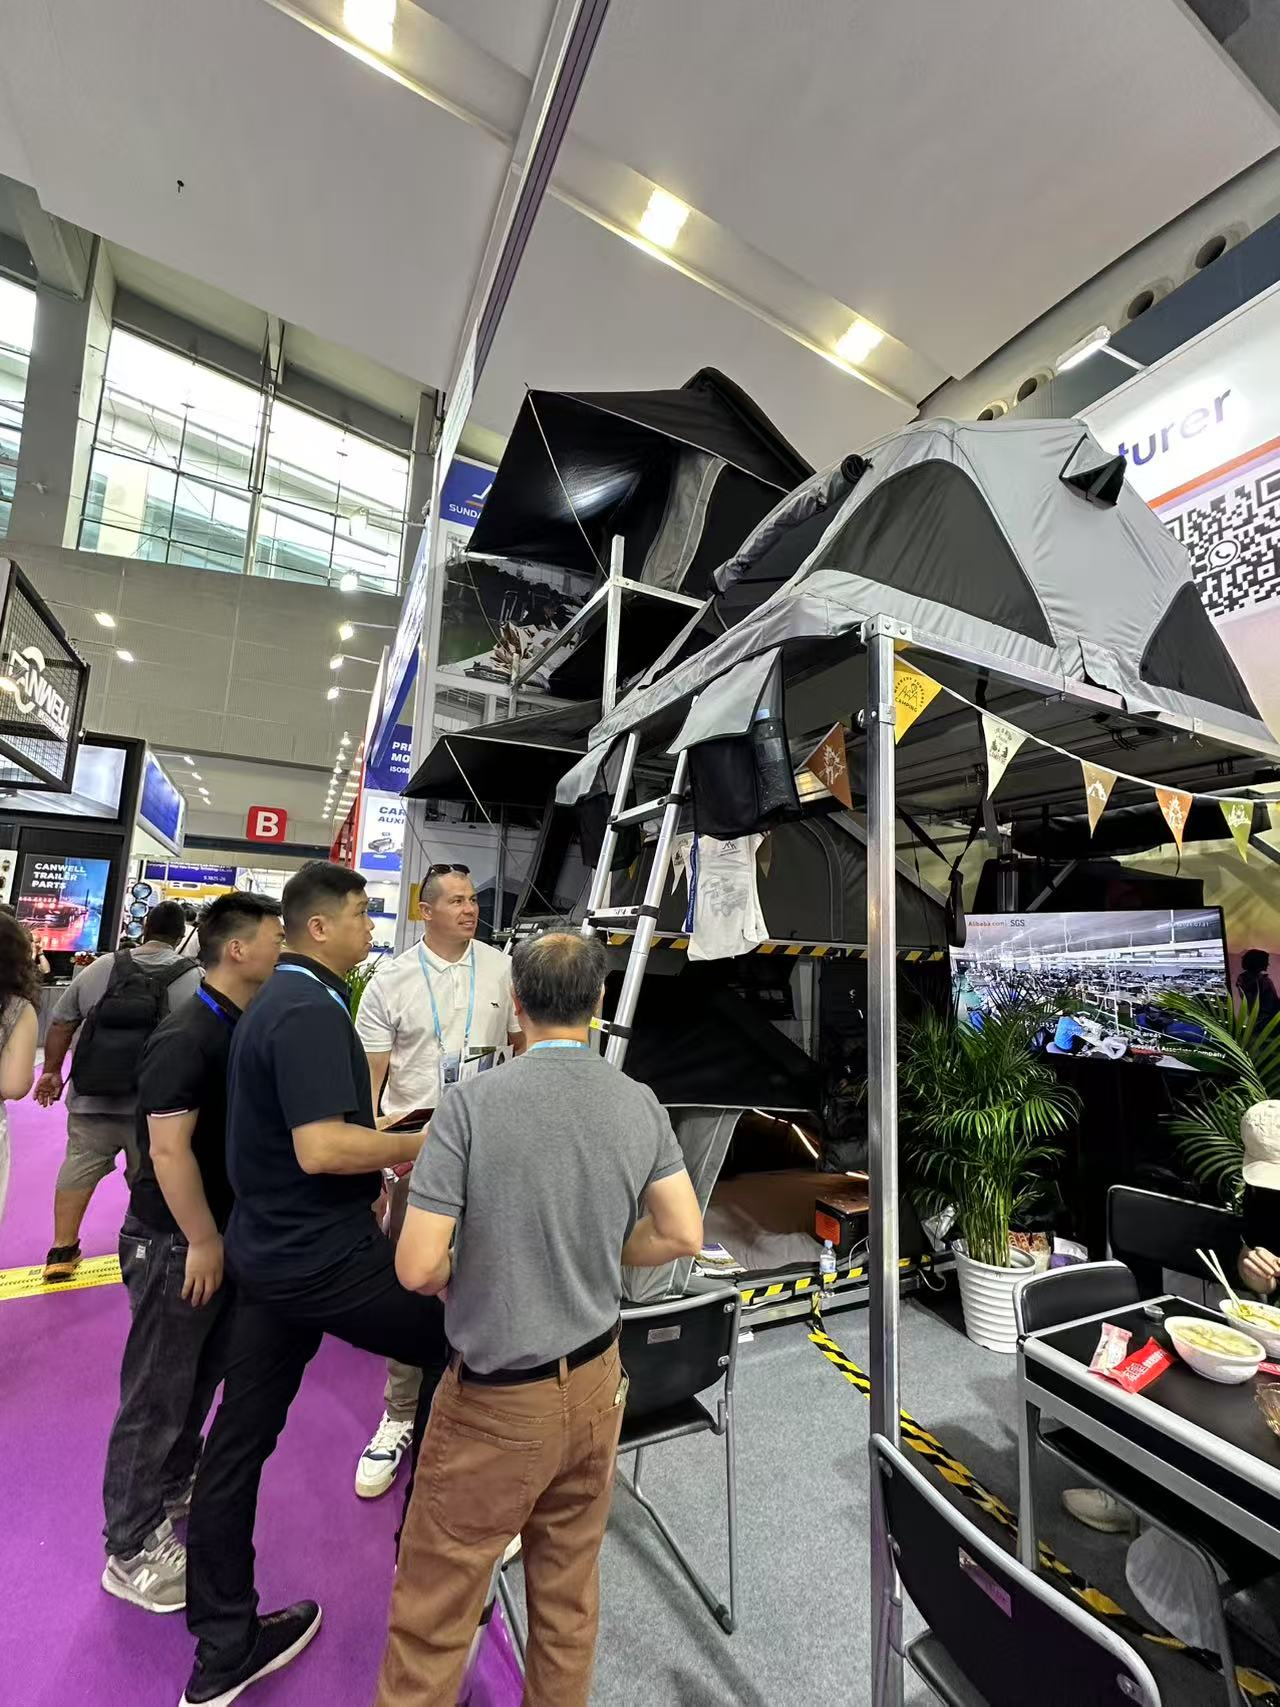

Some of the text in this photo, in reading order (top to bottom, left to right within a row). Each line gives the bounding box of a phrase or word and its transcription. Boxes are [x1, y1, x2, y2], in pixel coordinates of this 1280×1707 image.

[256, 811, 279, 837] B
[34, 863, 87, 873] CANWELL
[33, 871, 78, 881] TRAILER
[31, 880, 67, 889] PARTS
[1010, 919, 1025, 927] SGS
[133, 1568, 159, 1593] N
